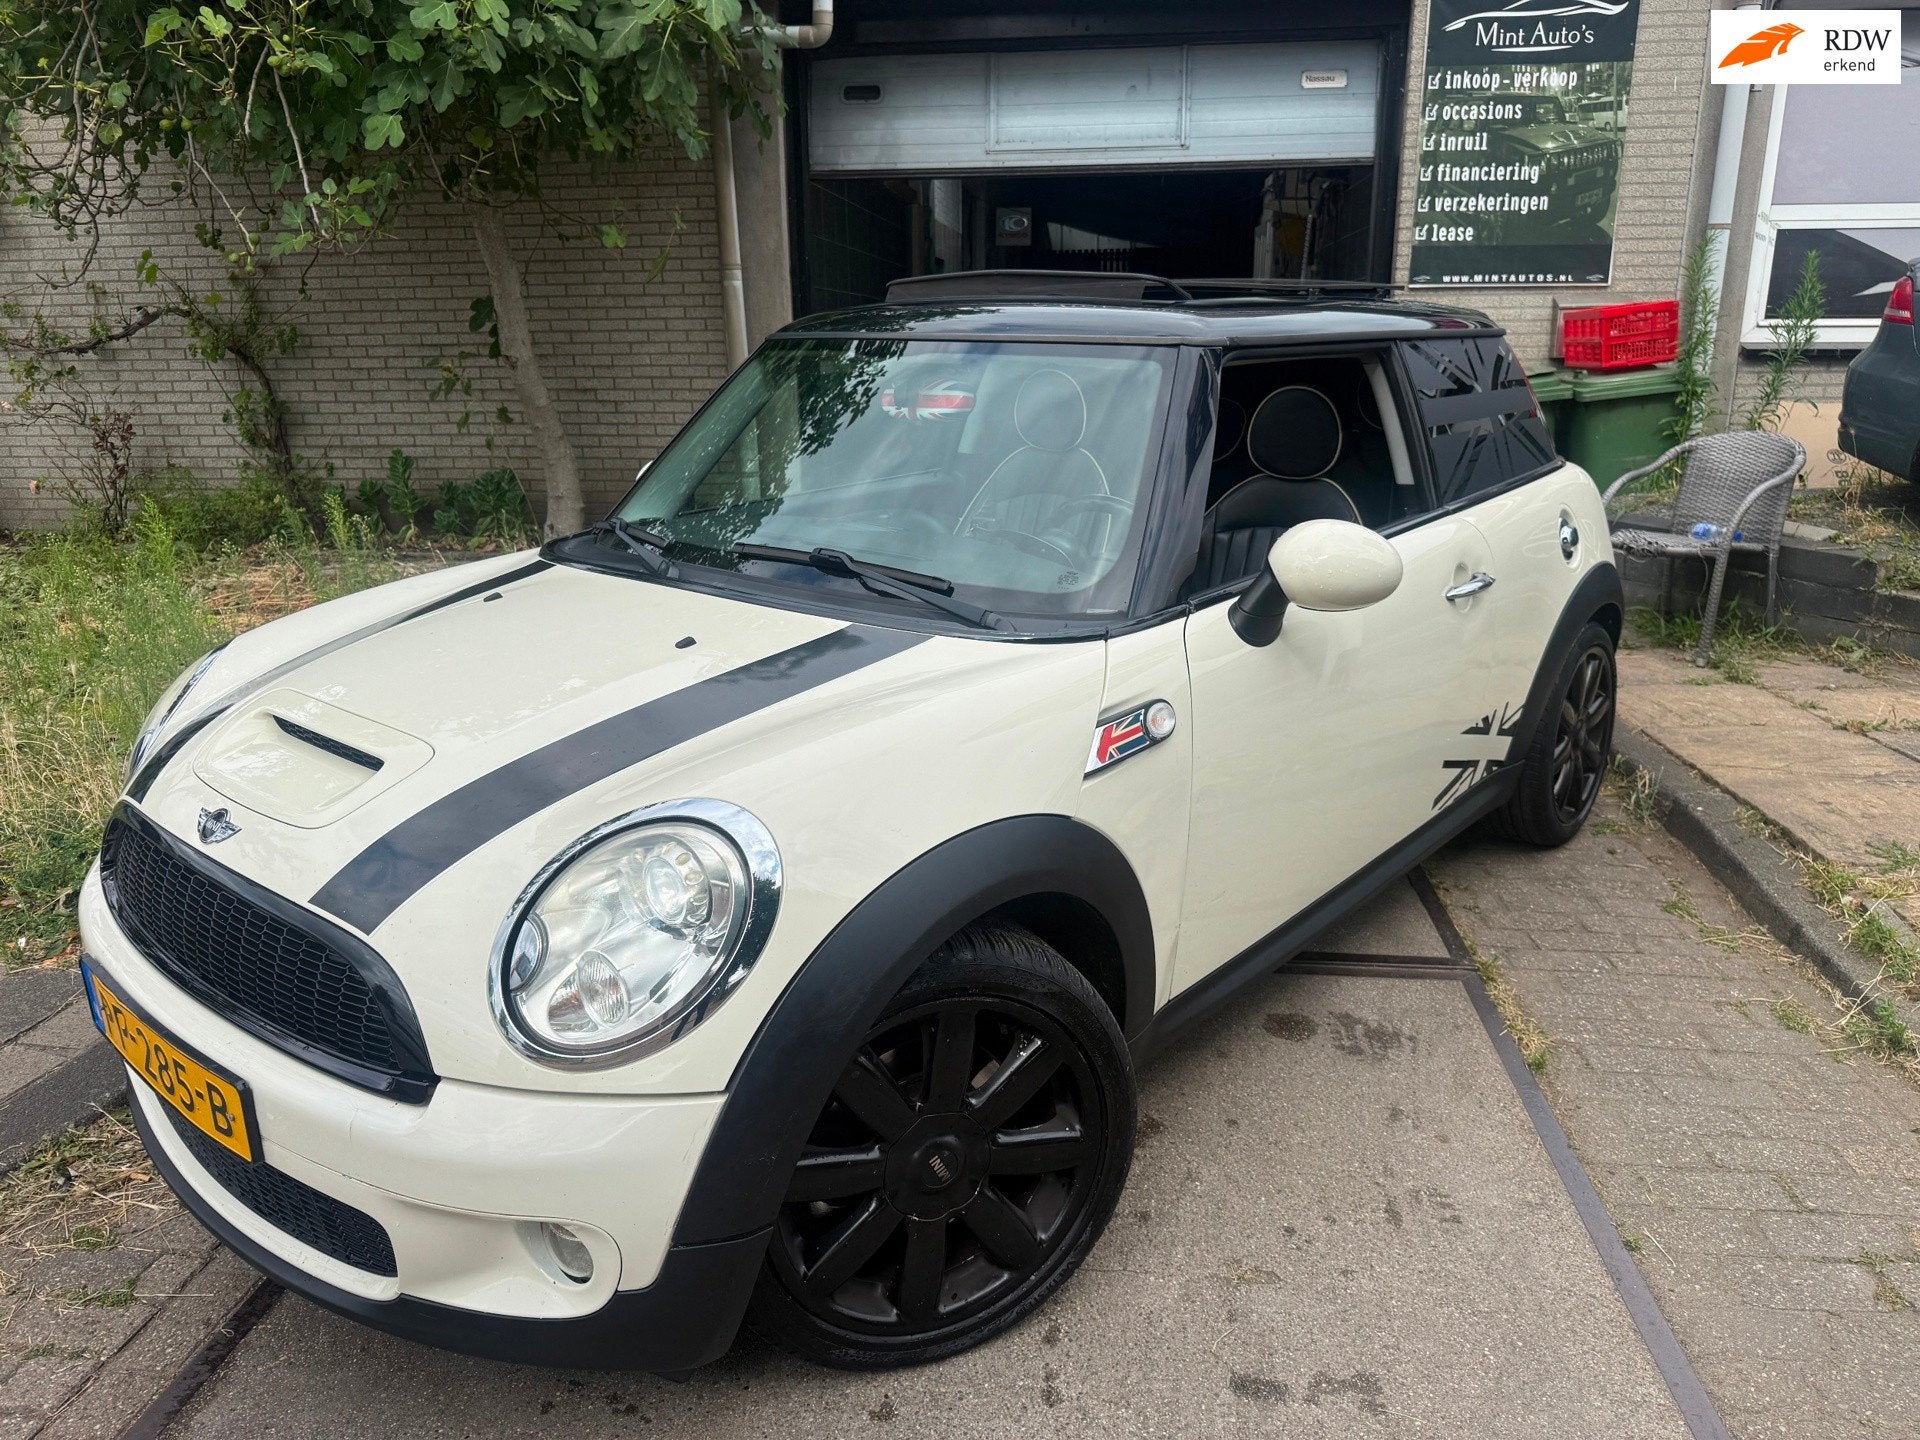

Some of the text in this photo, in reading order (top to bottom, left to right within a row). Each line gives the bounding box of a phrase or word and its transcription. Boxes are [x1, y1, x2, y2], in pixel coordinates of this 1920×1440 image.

[1475, 20, 1594, 46] Mint Auto's
[1442, 101, 1523, 120] occasions
[1439, 132, 1488, 151] inruil
[1437, 162, 1540, 184] financiering
[1434, 192, 1549, 214] verzekeringen
[1431, 223, 1474, 242] lease
[929, 1155, 951, 1181] MINI
